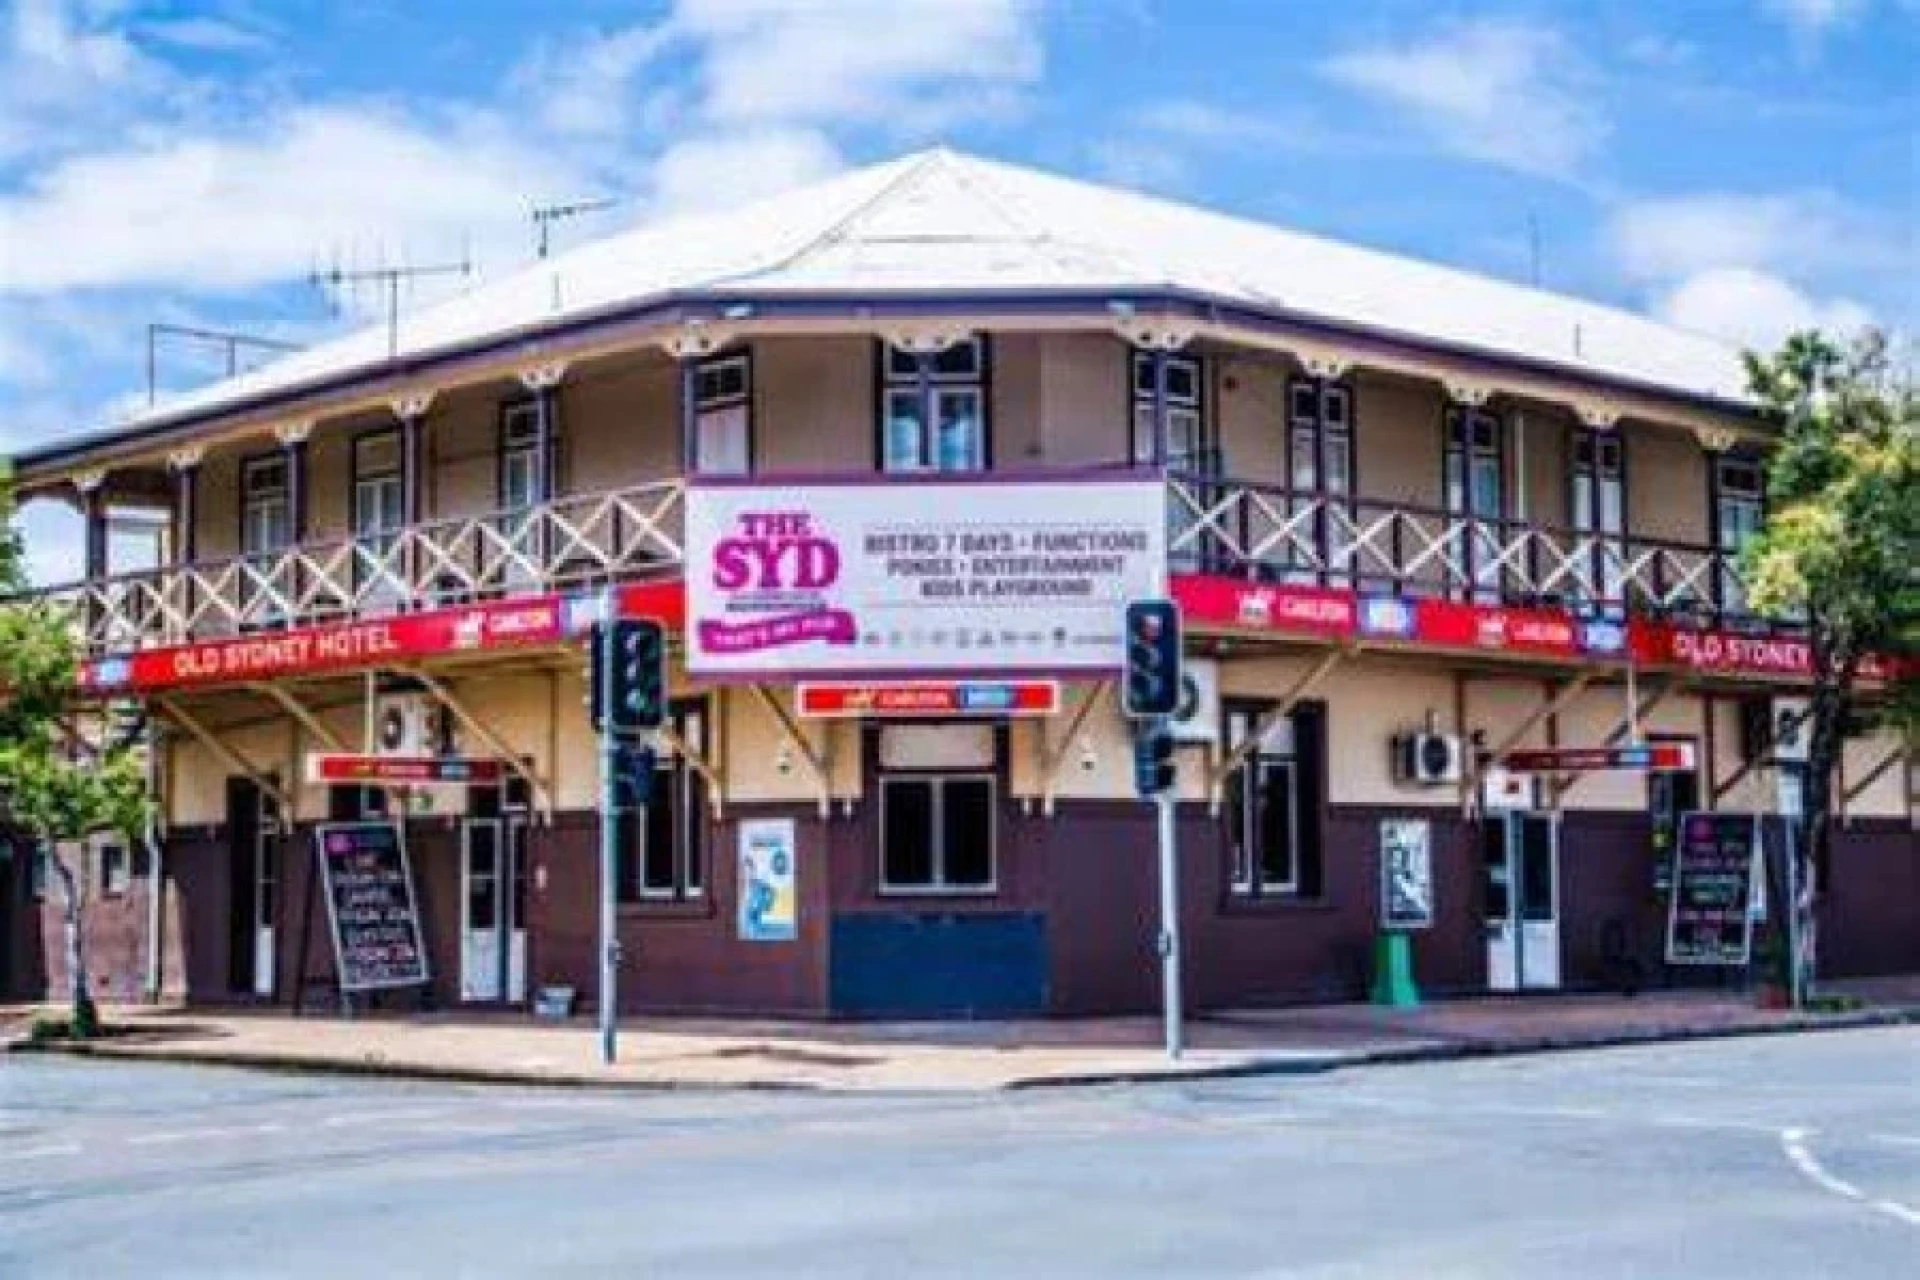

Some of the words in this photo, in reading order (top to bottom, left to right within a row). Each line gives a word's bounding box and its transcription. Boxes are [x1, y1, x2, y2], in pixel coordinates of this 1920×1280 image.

[739, 513, 811, 536] THE
[864, 532, 939, 554] BISTRO
[946, 532, 957, 552] 7
[962, 531, 1013, 554] DAYS
[1031, 528, 1147, 552] FUNCTIONS
[713, 539, 839, 588] SYD
[971, 554, 1123, 575] ENTERTAINMENT
[921, 578, 964, 596] KIDS
[968, 577, 1092, 596] PLAYGROUND
[173, 648, 221, 678] OLD
[223, 635, 312, 672] SYDNEY
[316, 623, 399, 658] HOTEL
[1672, 631, 1722, 666] OLD
[1726, 637, 1810, 668] SYDNEY
